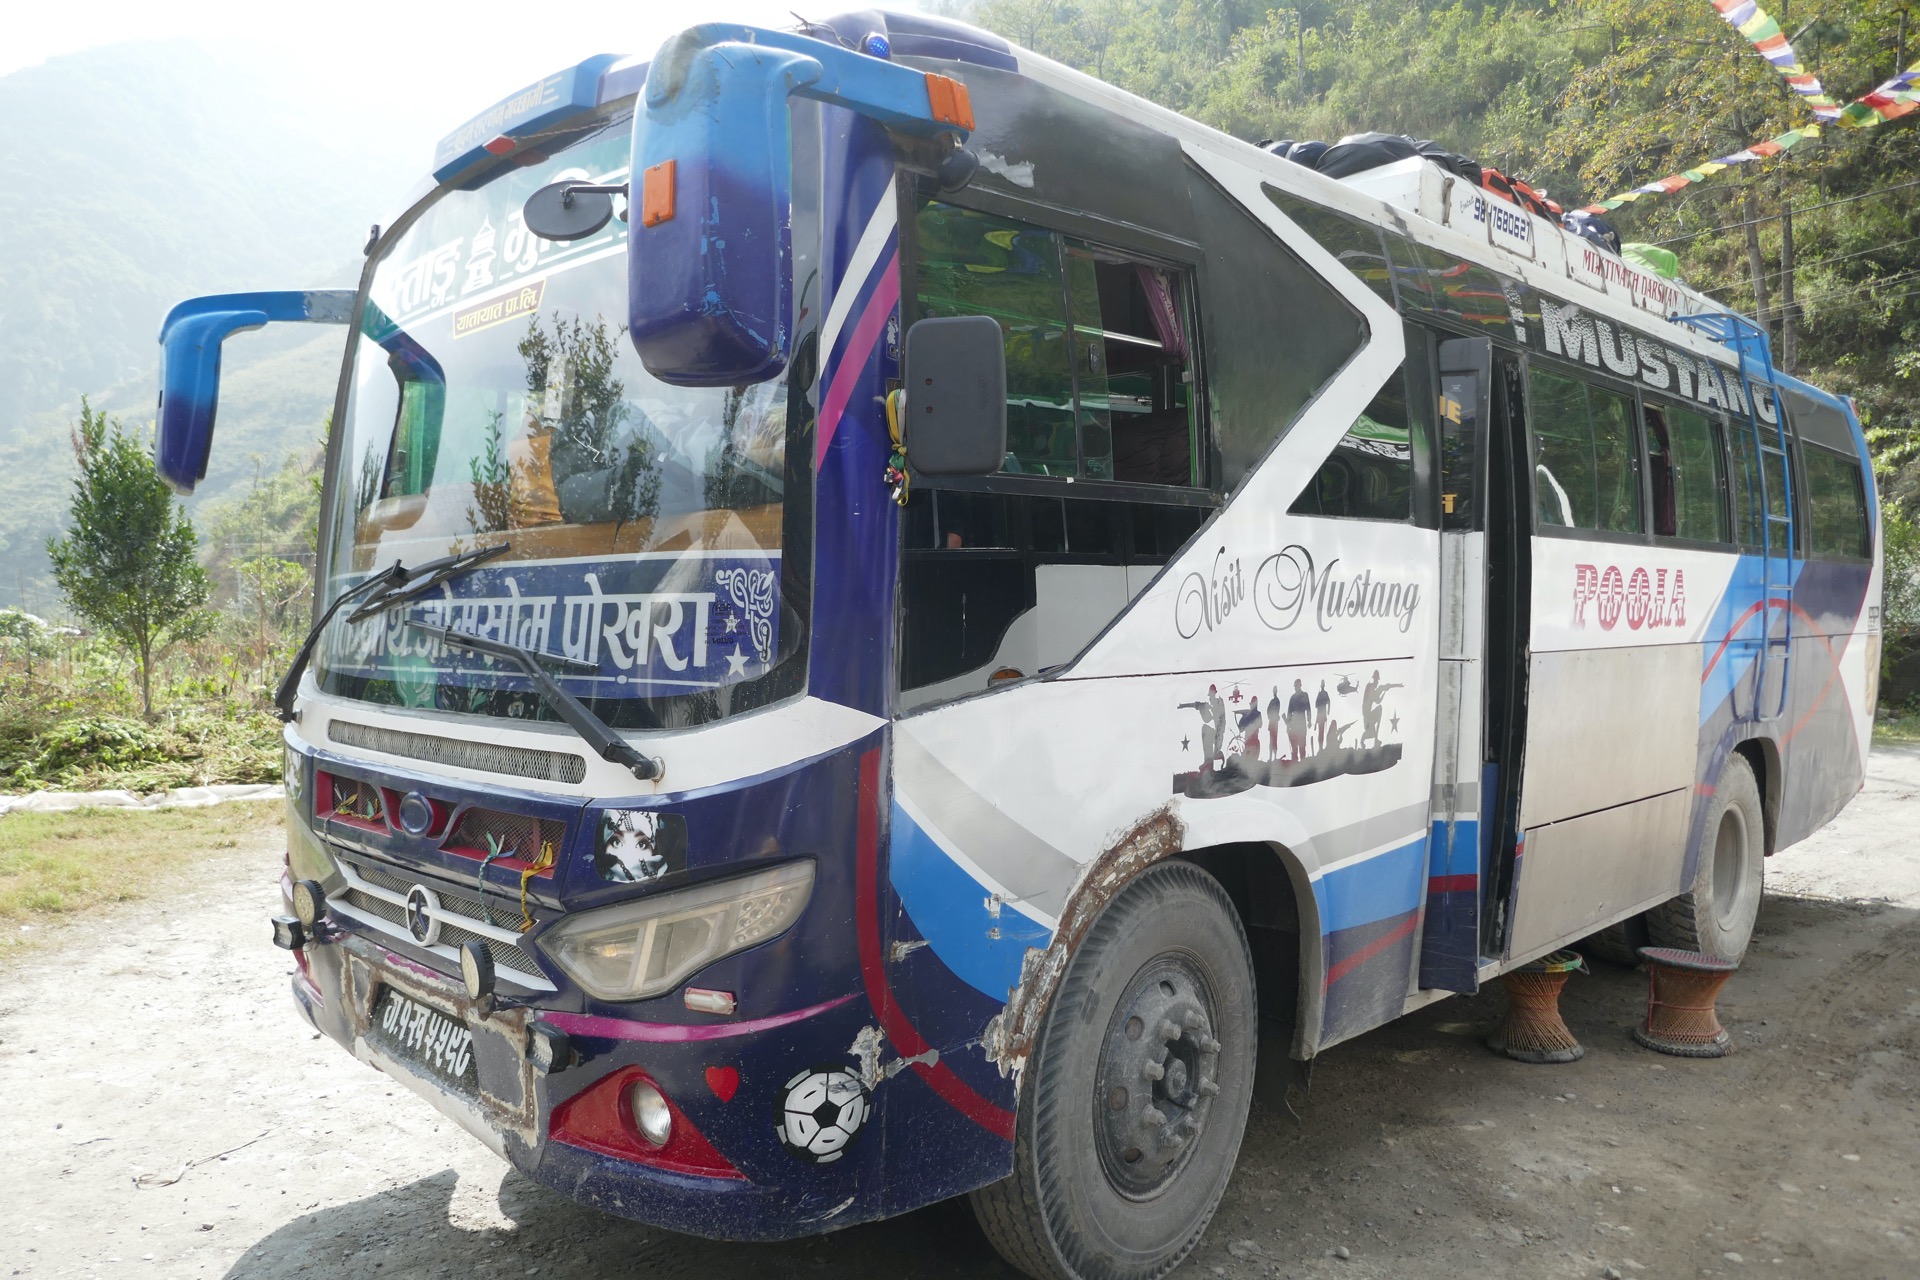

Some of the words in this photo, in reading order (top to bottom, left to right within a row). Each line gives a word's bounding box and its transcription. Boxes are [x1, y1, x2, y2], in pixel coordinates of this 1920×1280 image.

[456, 302, 504, 331] यातायात
[562, 572, 716, 672] पोखरा
[1175, 545, 1245, 640] Visit
[1253, 543, 1420, 634] Mustang
[1572, 563, 1687, 632] POOJA
